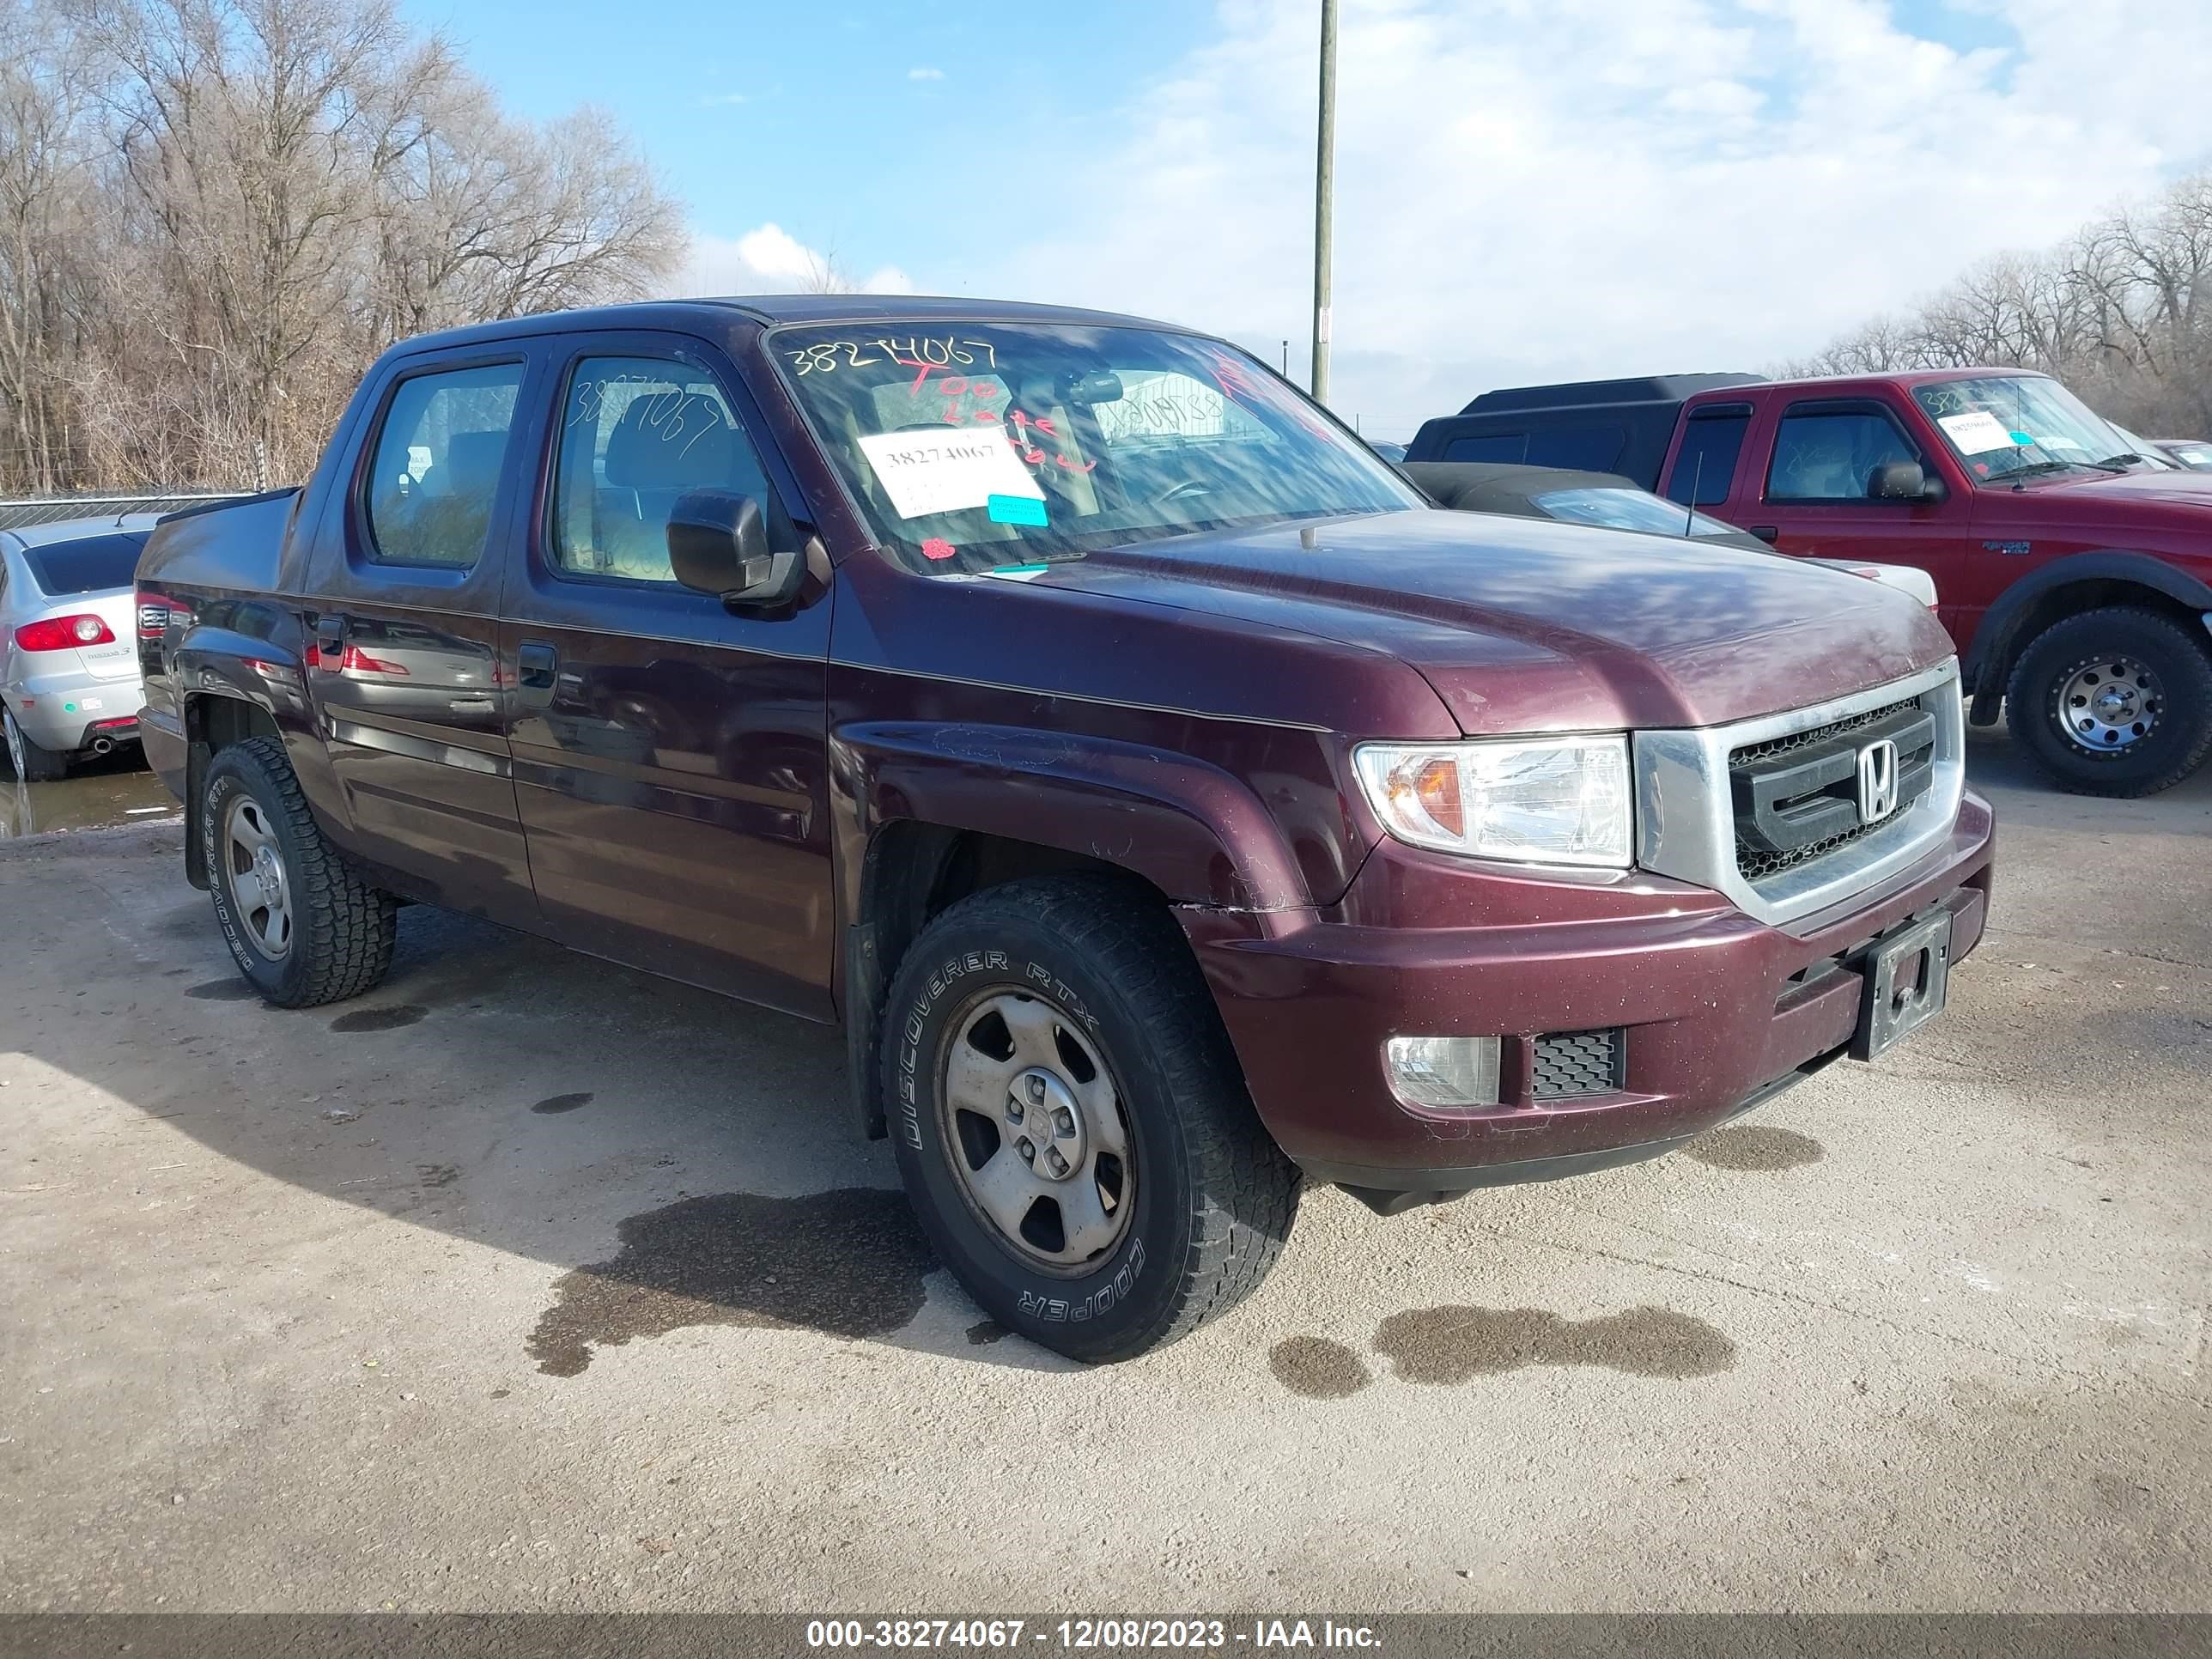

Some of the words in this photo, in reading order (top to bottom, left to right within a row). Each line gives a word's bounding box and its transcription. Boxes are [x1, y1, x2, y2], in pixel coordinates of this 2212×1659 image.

[783, 337, 997, 376] 38274067
[886, 446, 994, 468] 38274067
[896, 950, 1009, 1151] DISCOVERER
[1025, 962, 1100, 1032] RTX
[1018, 1237, 1147, 1323] COOPER
